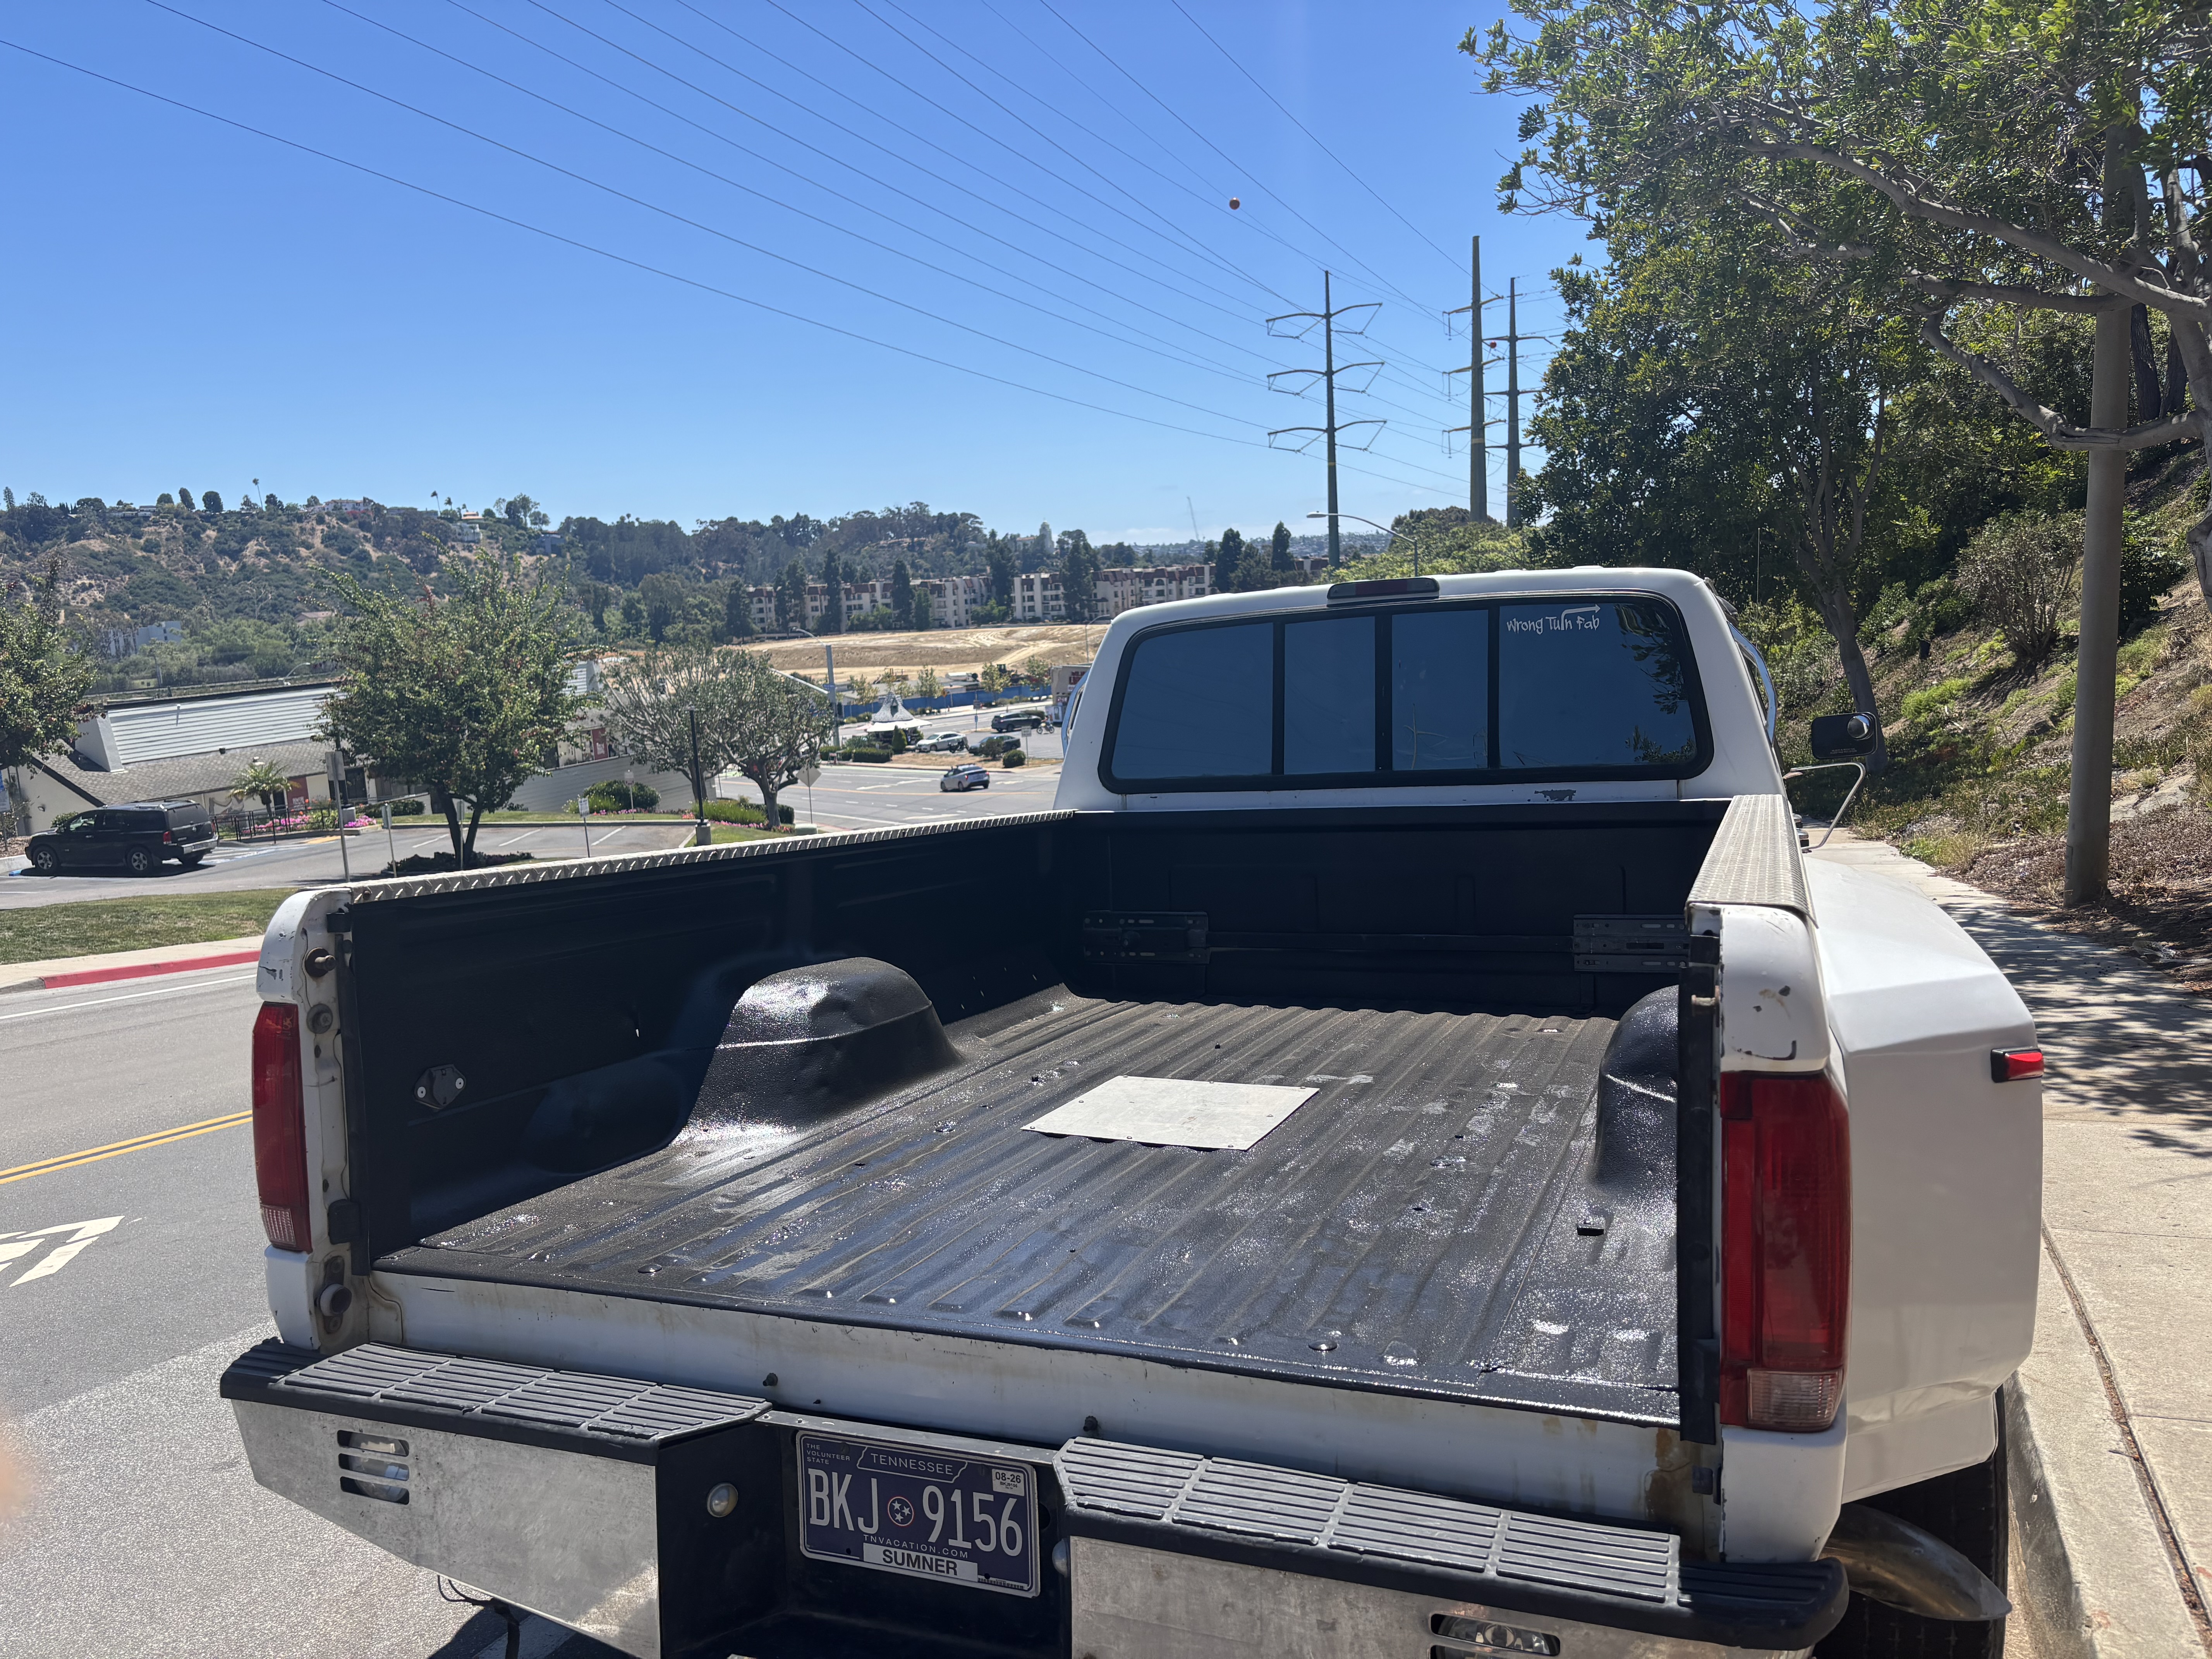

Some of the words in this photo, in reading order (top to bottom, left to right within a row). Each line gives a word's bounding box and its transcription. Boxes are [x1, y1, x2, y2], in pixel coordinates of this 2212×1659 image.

[1506, 618, 1543, 635] Wrong
[1576, 615, 1599, 631] Fab
[807, 1450, 850, 1461] VOLUNTEER
[807, 1456, 830, 1465] STATE
[871, 1453, 953, 1475] TENNESSEE
[995, 1471, 1021, 1484] 08-26
[808, 1468, 879, 1534] BKJ
[922, 1485, 1023, 1556] 9156
[863, 1534, 968, 1558] TNVACATION.COM
[883, 1549, 958, 1576] SUMNER
